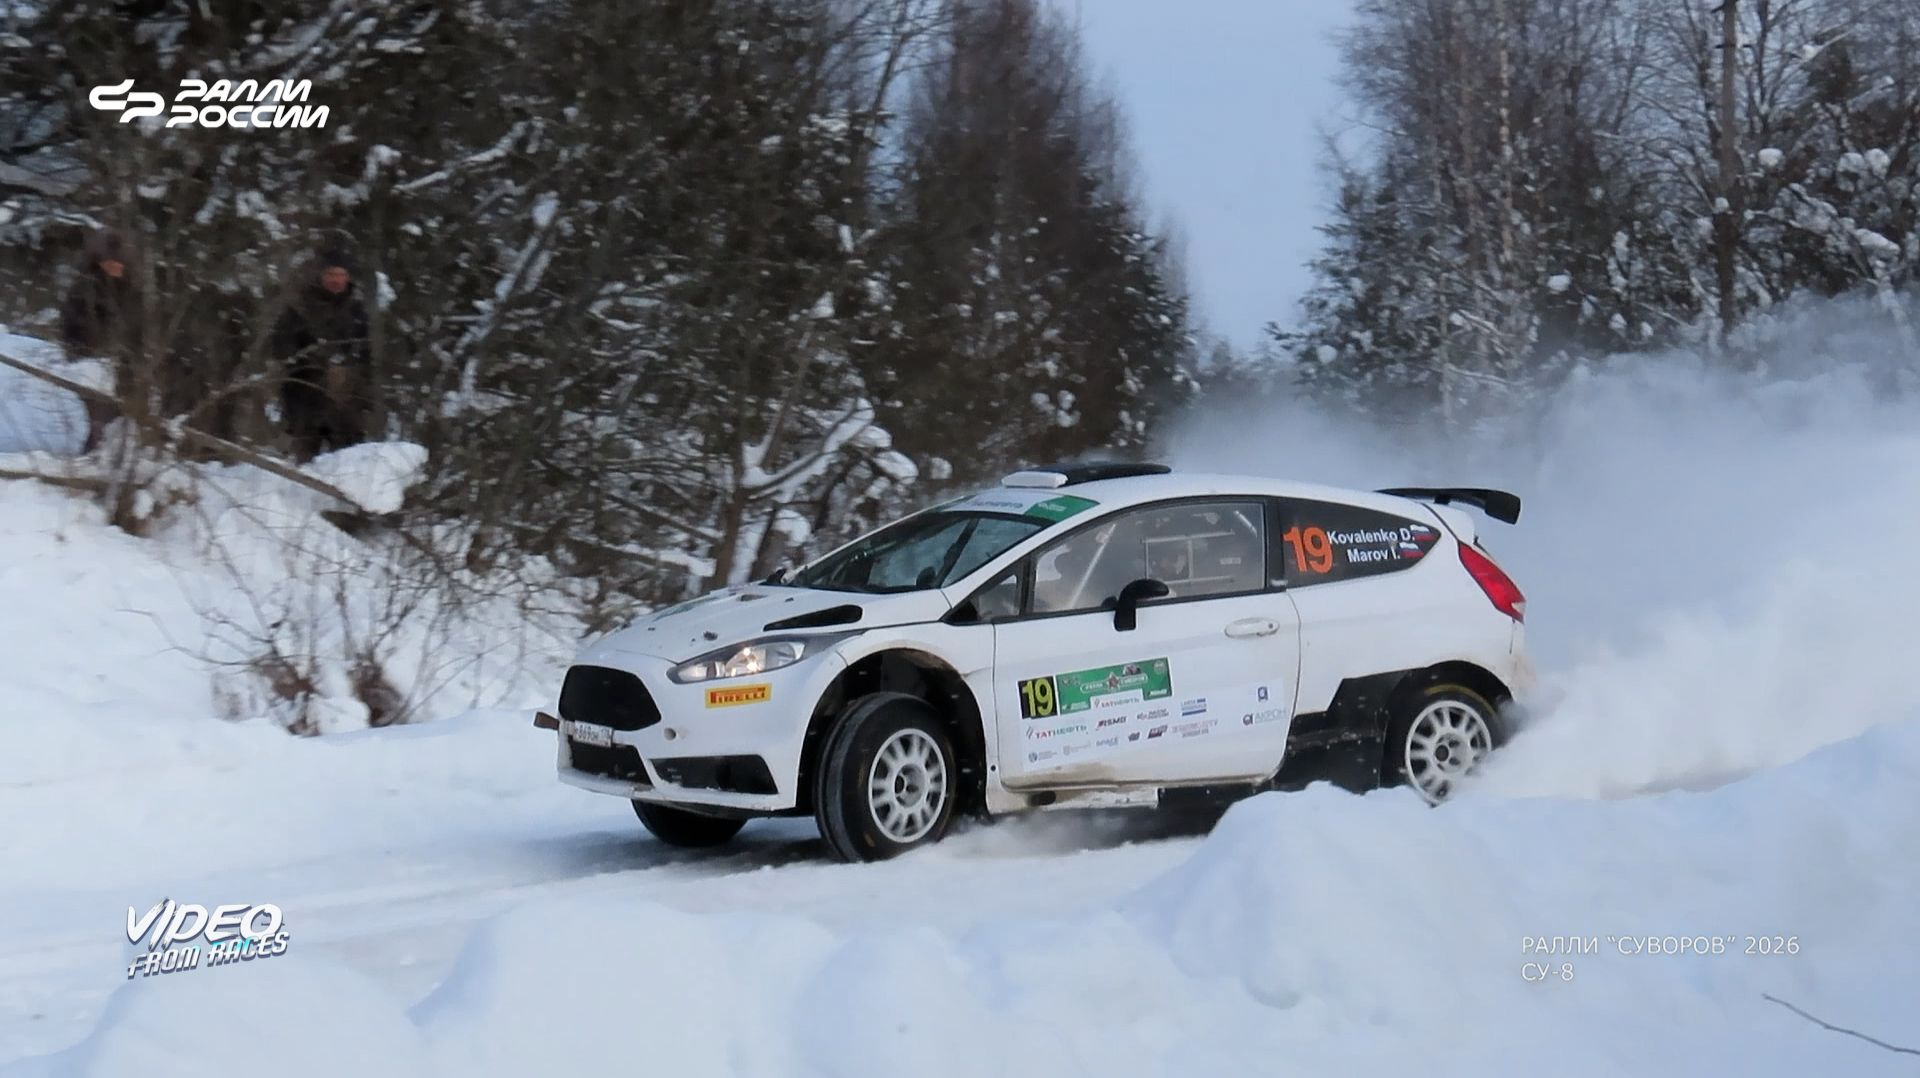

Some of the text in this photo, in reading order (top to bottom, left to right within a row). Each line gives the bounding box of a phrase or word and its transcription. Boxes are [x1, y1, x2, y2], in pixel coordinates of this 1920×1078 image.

[1327, 528, 1416, 545] Kovalenko D.
[1283, 526, 1334, 573] 19
[1347, 549, 1389, 563] Marov
[709, 687, 766, 704] PIRELLI
[1021, 677, 1055, 717] 19
